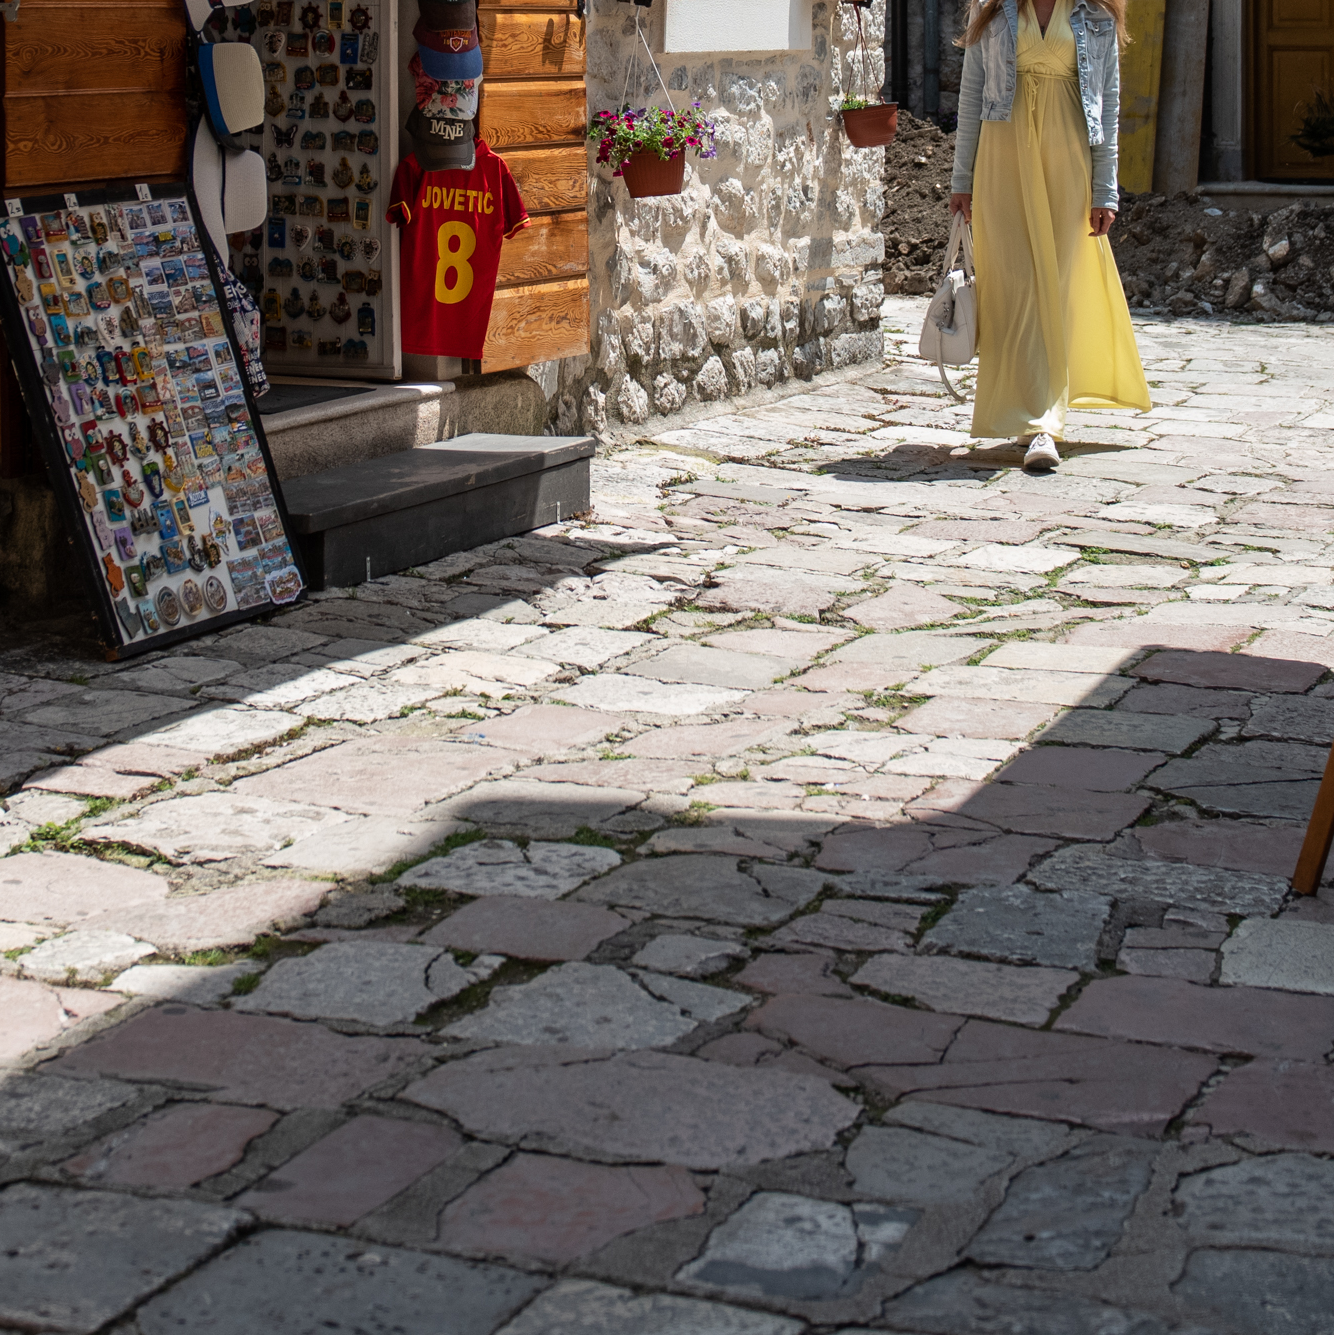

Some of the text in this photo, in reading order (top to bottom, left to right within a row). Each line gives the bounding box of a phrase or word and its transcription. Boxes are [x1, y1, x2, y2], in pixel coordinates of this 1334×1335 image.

[430, 120, 464, 140] MNE
[422, 184, 495, 215] JOVETIĆ
[434, 221, 477, 304] 8
